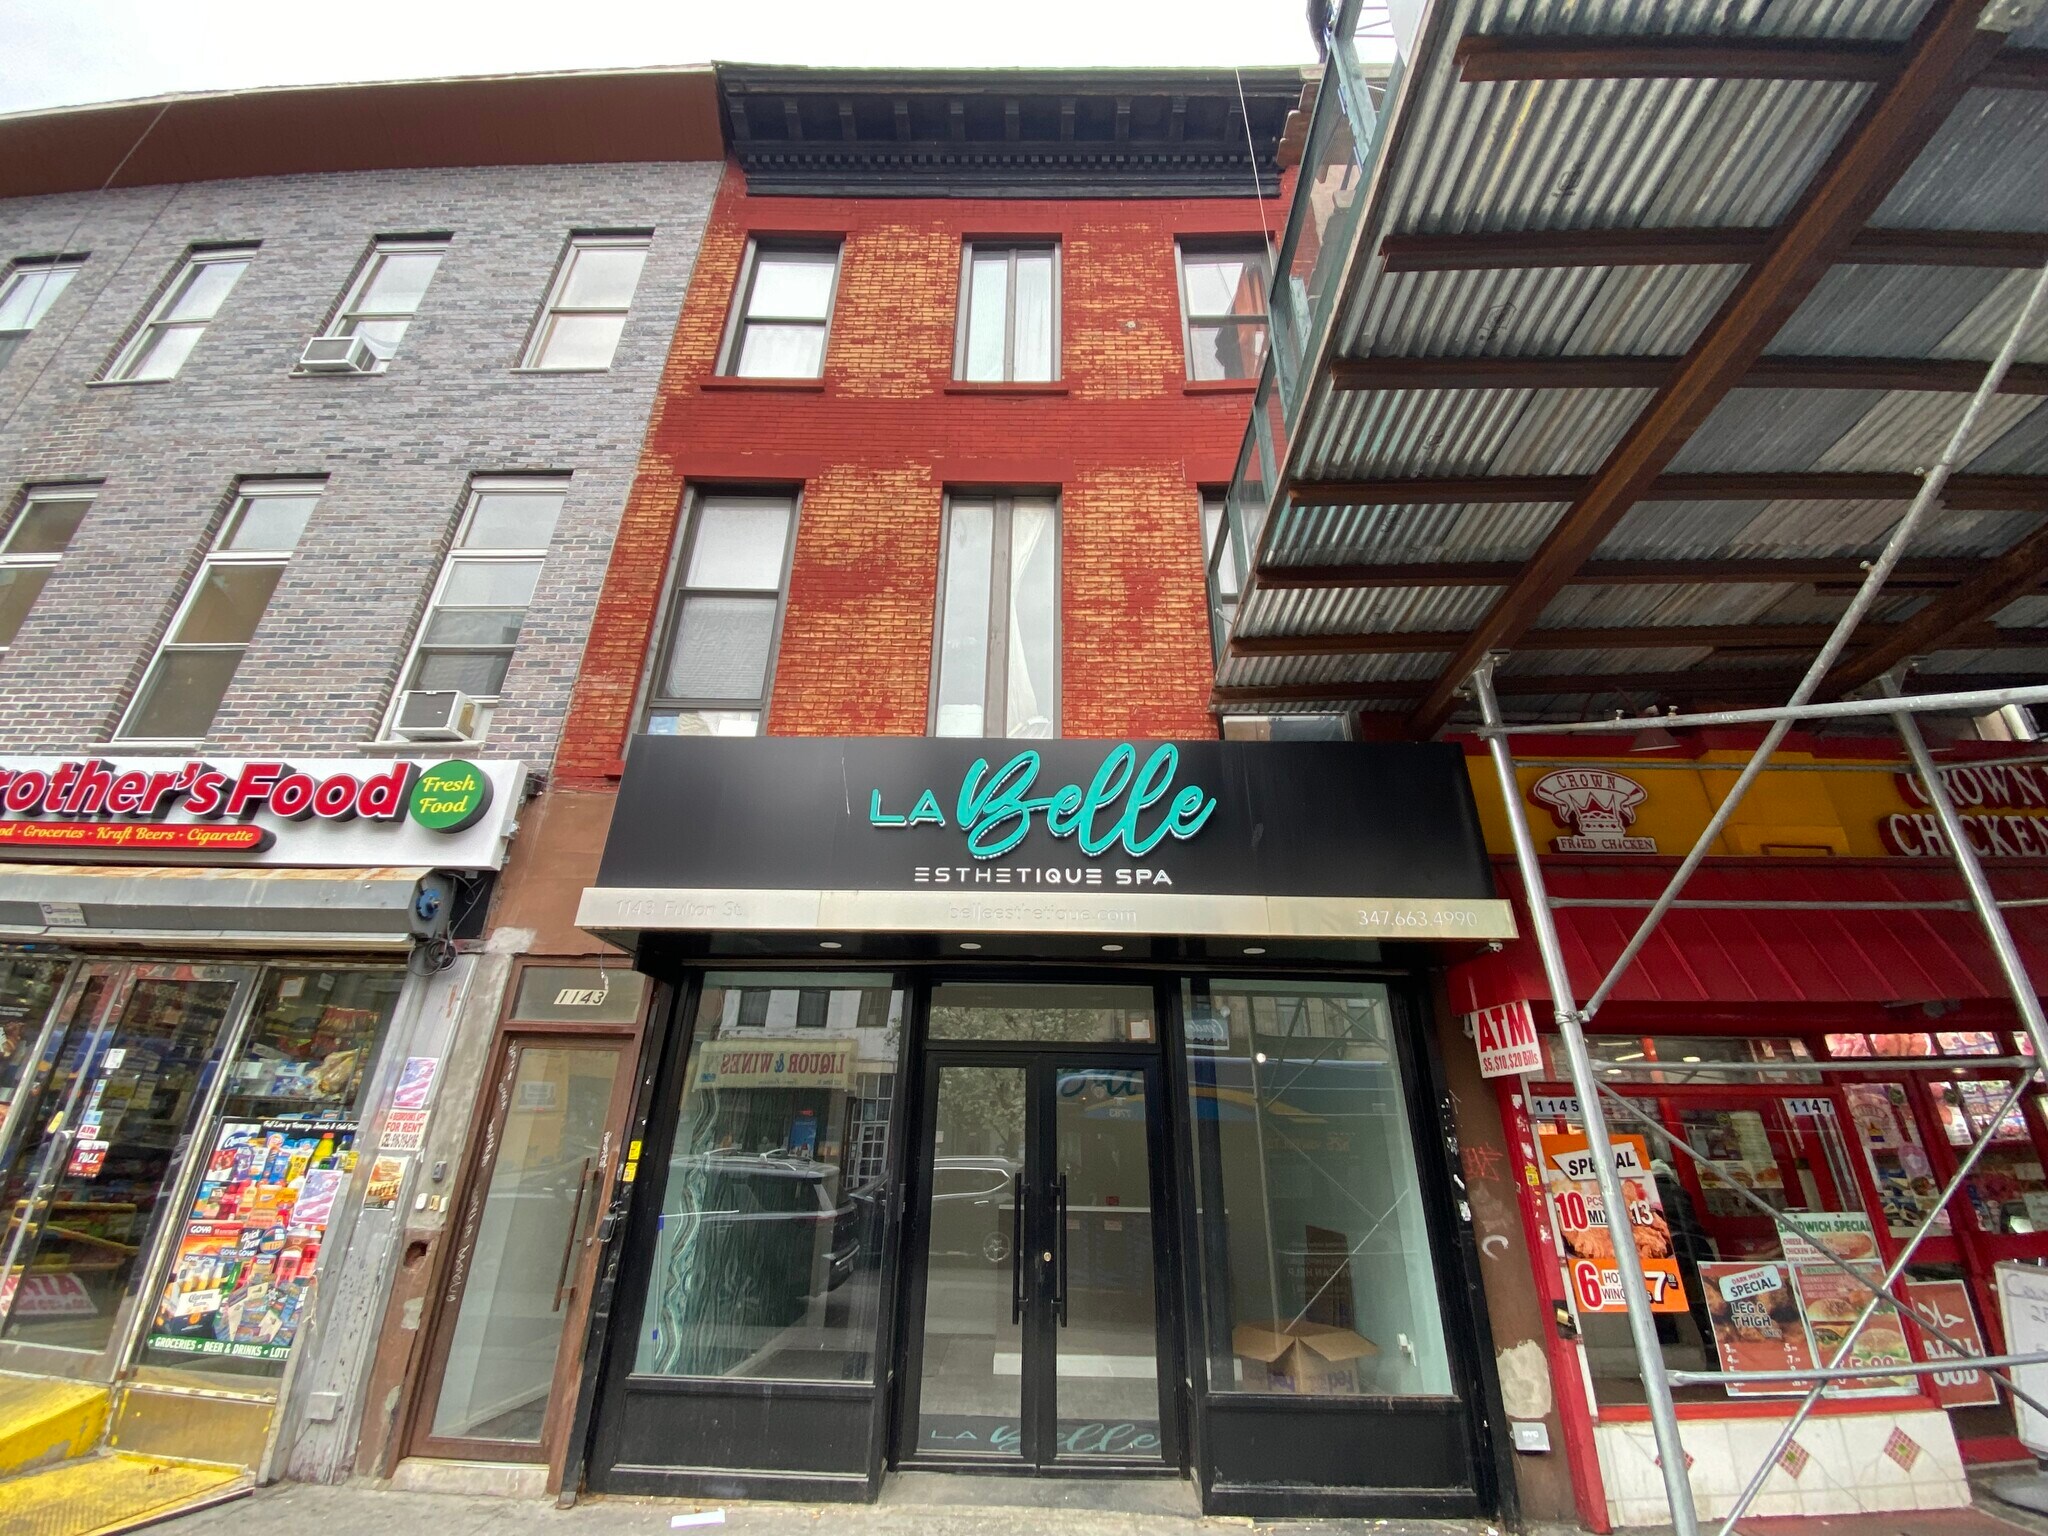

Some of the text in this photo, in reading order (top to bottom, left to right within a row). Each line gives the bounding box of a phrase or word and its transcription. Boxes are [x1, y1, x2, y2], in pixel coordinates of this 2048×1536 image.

[225, 761, 413, 819] Food
[422, 775, 477, 796] Fresh
[1557, 774, 1616, 789] CROWN
[419, 796, 467, 814] Food
[869, 742, 1218, 860] LA Belle
[24, 824, 84, 839] Groceries
[97, 827, 131, 845] Kraft
[136, 828, 175, 840] Beers
[187, 828, 254, 845] Cigarette
[1560, 838, 1654, 850] FRIED CHICKEN
[914, 867, 1173, 886] ESTHETIQUE SPA
[1358, 909, 1478, 927] 347.663.4990
[557, 990, 605, 1004] 1143
[1478, 1001, 1535, 1053] ATM
[1536, 1100, 1580, 1112] 1145
[1790, 1099, 1832, 1113] 1147
[385, 1121, 424, 1133] FOR RENT
[77, 1151, 100, 1164] PULL
[1568, 1151, 1636, 1176] SPEAL
[1555, 1192, 1588, 1231] 10
[190, 1225, 212, 1234] GOYA
[1777, 1219, 1872, 1233] SDWICH SPECIAL
[1576, 1261, 1620, 1308] 6 HO
[1730, 1277, 1777, 1298] SPECIAL
[1731, 1302, 1766, 1314] LEG &
[1732, 1316, 1771, 1327] THIGH
[154, 1337, 197, 1351] GROCERIES
[203, 1341, 224, 1353] BEER
[224, 1342, 232, 1354] &
[232, 1343, 263, 1356] DRINKS
[1923, 1337, 1981, 1360] ALAL
[1933, 1368, 1979, 1387] OOD
[930, 1429, 978, 1440] LA
